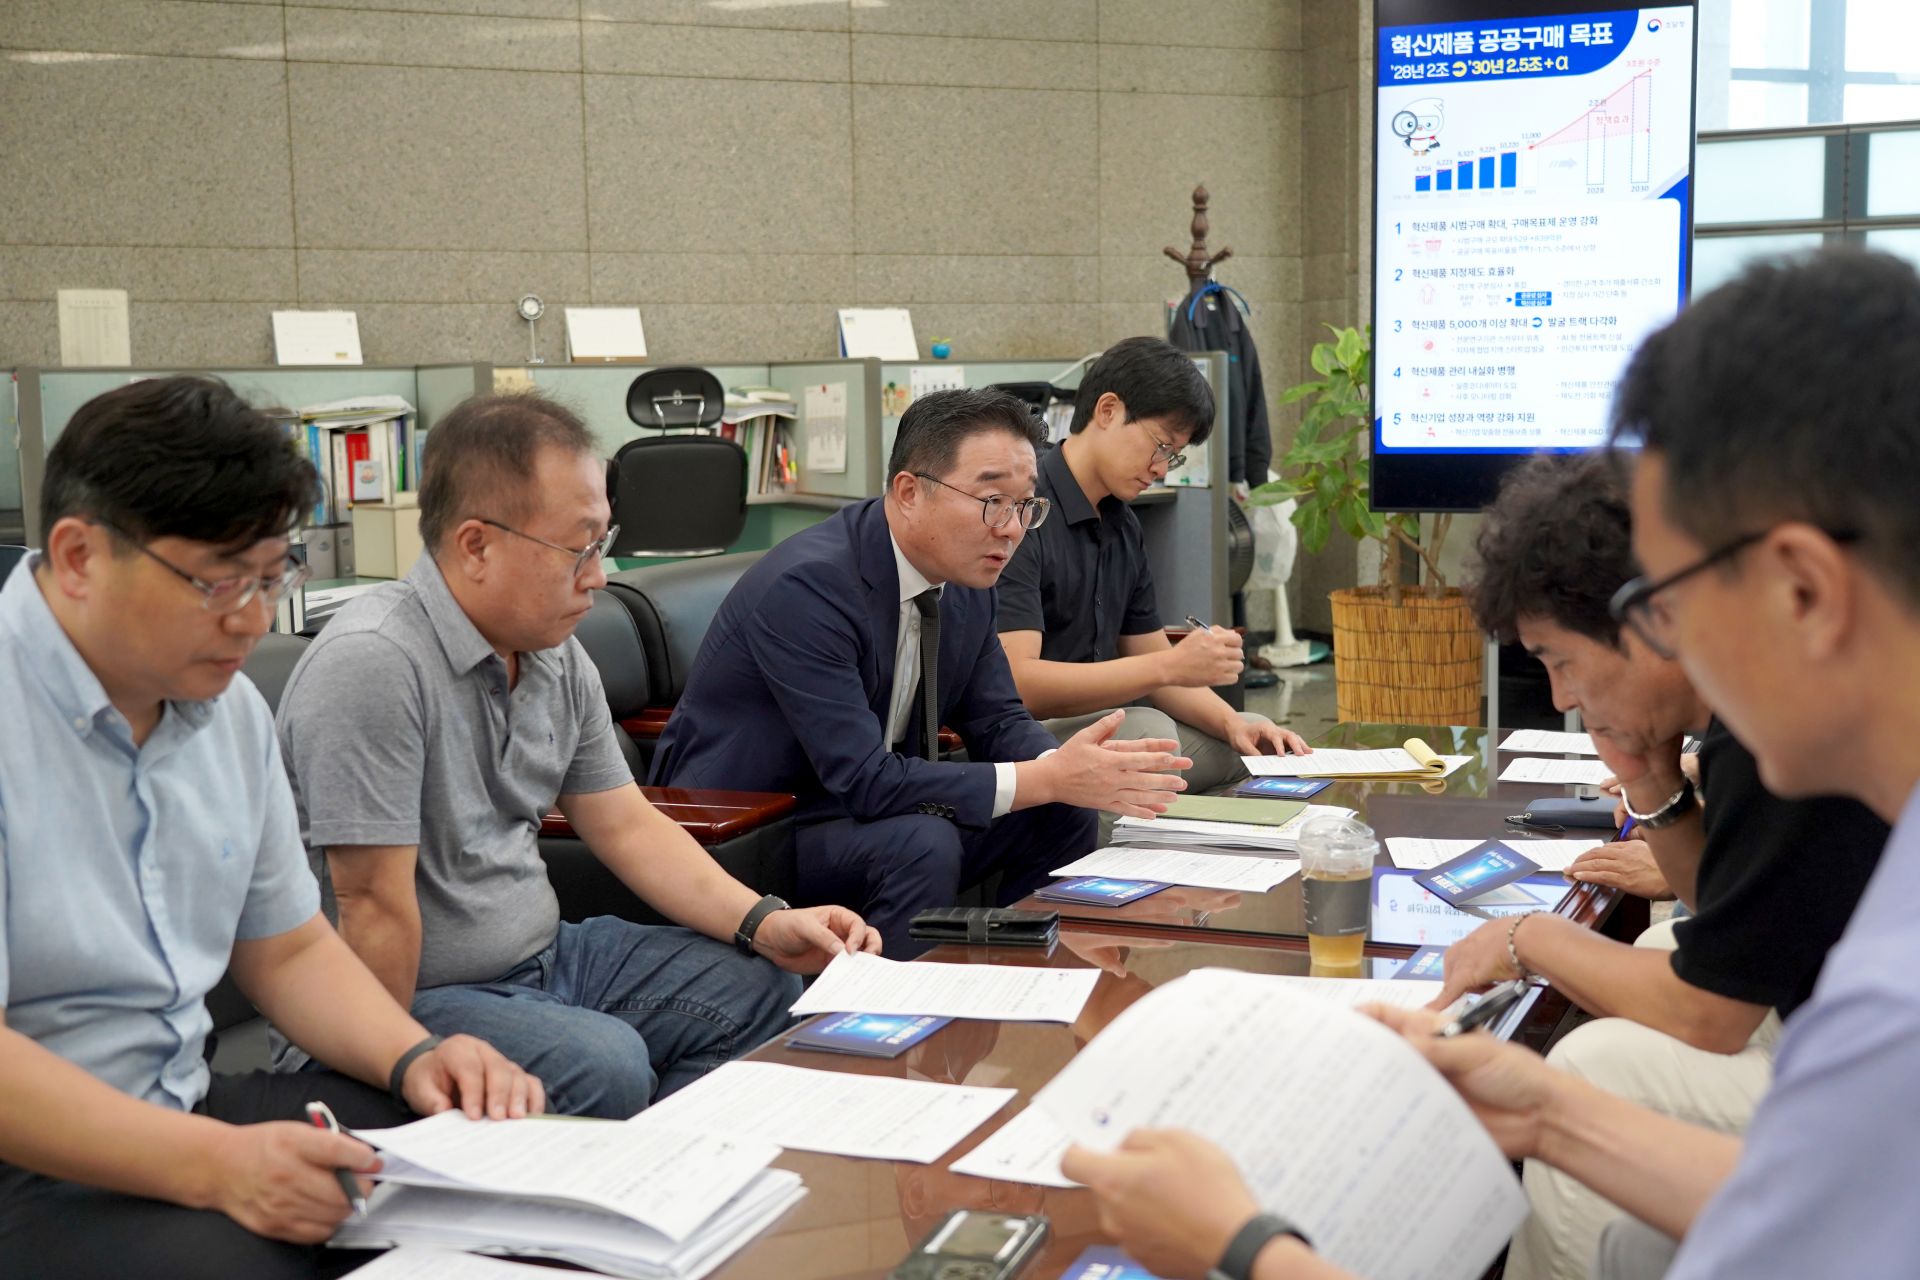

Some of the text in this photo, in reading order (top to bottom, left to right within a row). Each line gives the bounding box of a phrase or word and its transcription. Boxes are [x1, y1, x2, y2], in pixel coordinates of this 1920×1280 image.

[1391, 22, 1614, 58] 혁신제품 공공구매 목표
[1390, 63, 1425, 80] '28년
[1426, 62, 1450, 78] 2조
[1468, 58, 1504, 75] '30년
[1631, 185, 1649, 193] 2030
[1395, 222, 1402, 235] 1
[1412, 221, 1447, 232] 혁신제품
[1450, 219, 1485, 230] 시범구매
[1511, 217, 1556, 229] 구매목표제
[1559, 216, 1577, 227] 운영
[1580, 215, 1598, 227] 강화
[1394, 266, 1515, 281] 2 혁신제품 지정제도 효율화
[1394, 315, 1617, 333] 3 혁신제품 5,000개 이상 확대 발굴 트랙 다각화
[1393, 365, 1516, 379] 4 혁신제품 관리 내실화 병행
[1393, 412, 1535, 425] 5 혁신기업 성장과 역량 강화 지원
